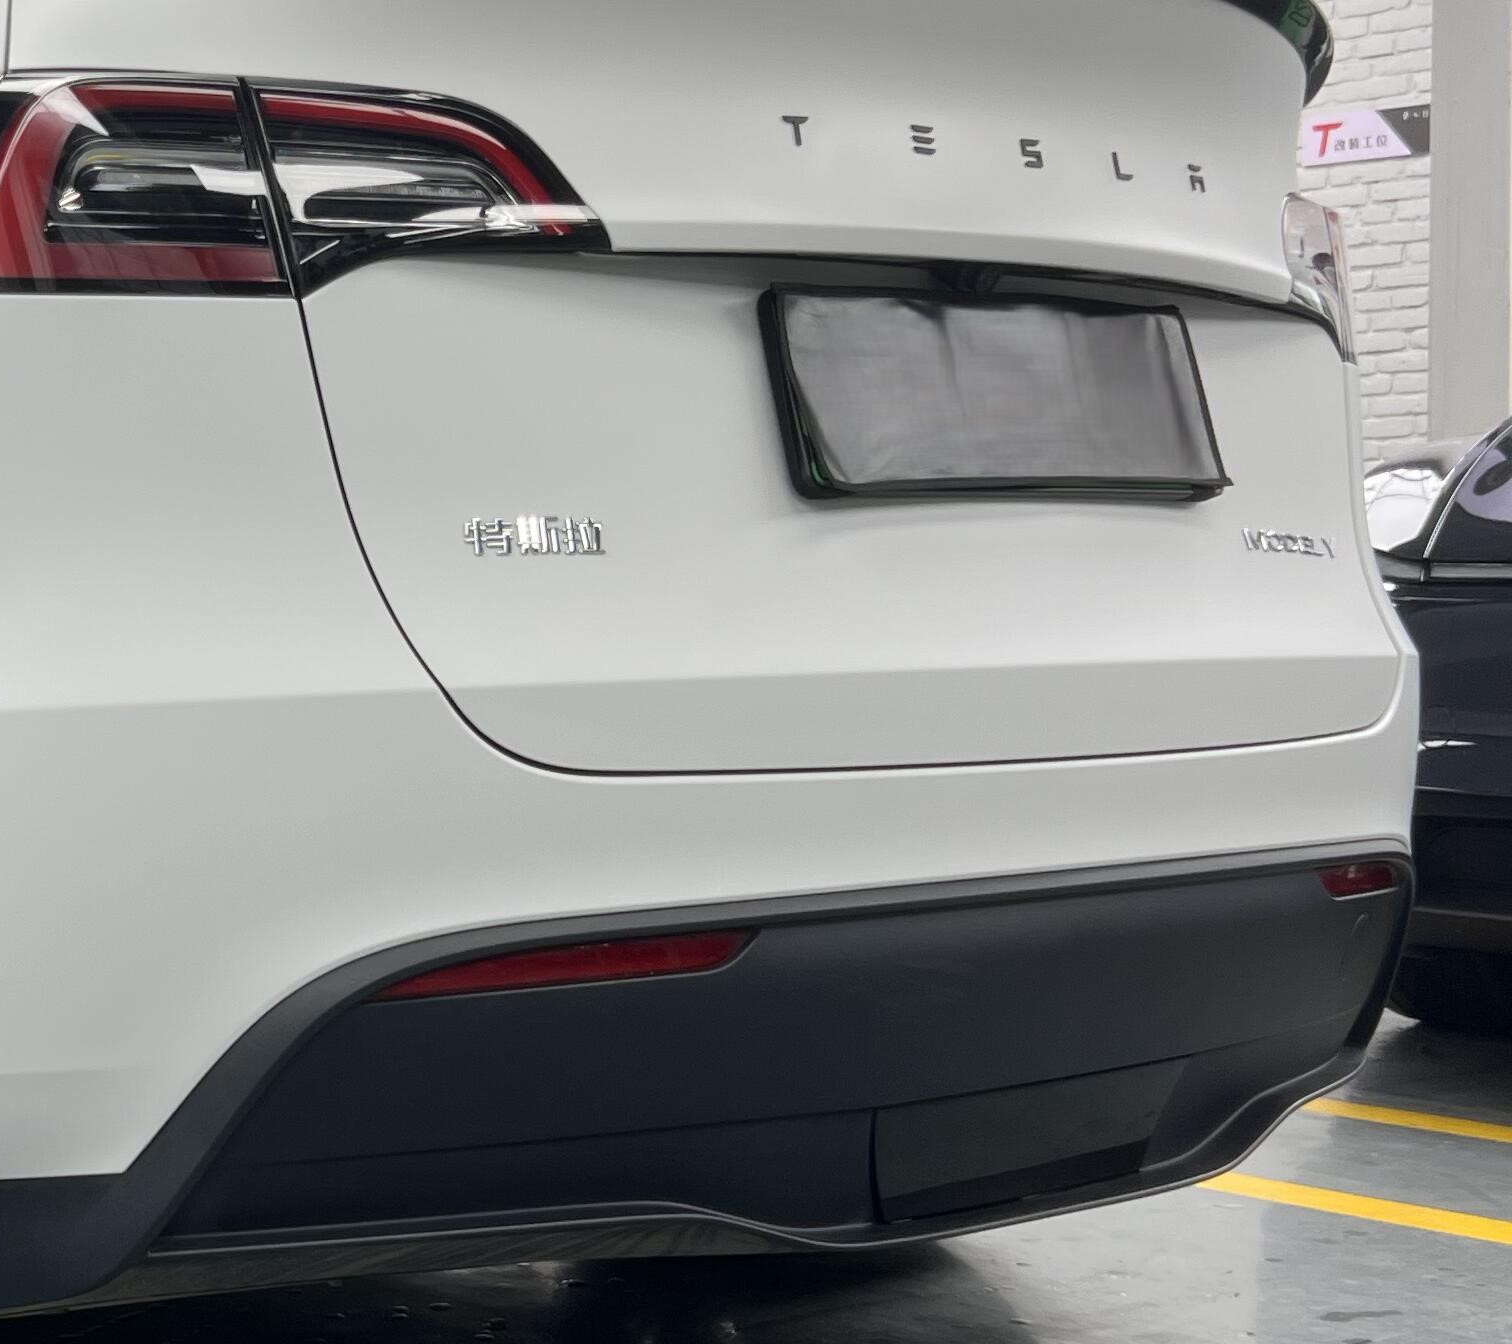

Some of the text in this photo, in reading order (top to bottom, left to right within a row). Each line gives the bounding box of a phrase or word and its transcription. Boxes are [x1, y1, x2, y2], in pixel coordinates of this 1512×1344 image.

[782, 115, 1206, 194] TESLA
[1312, 120, 1343, 158] T
[464, 515, 606, 555] 特斯拉
[1241, 527, 1325, 557] MODEL
